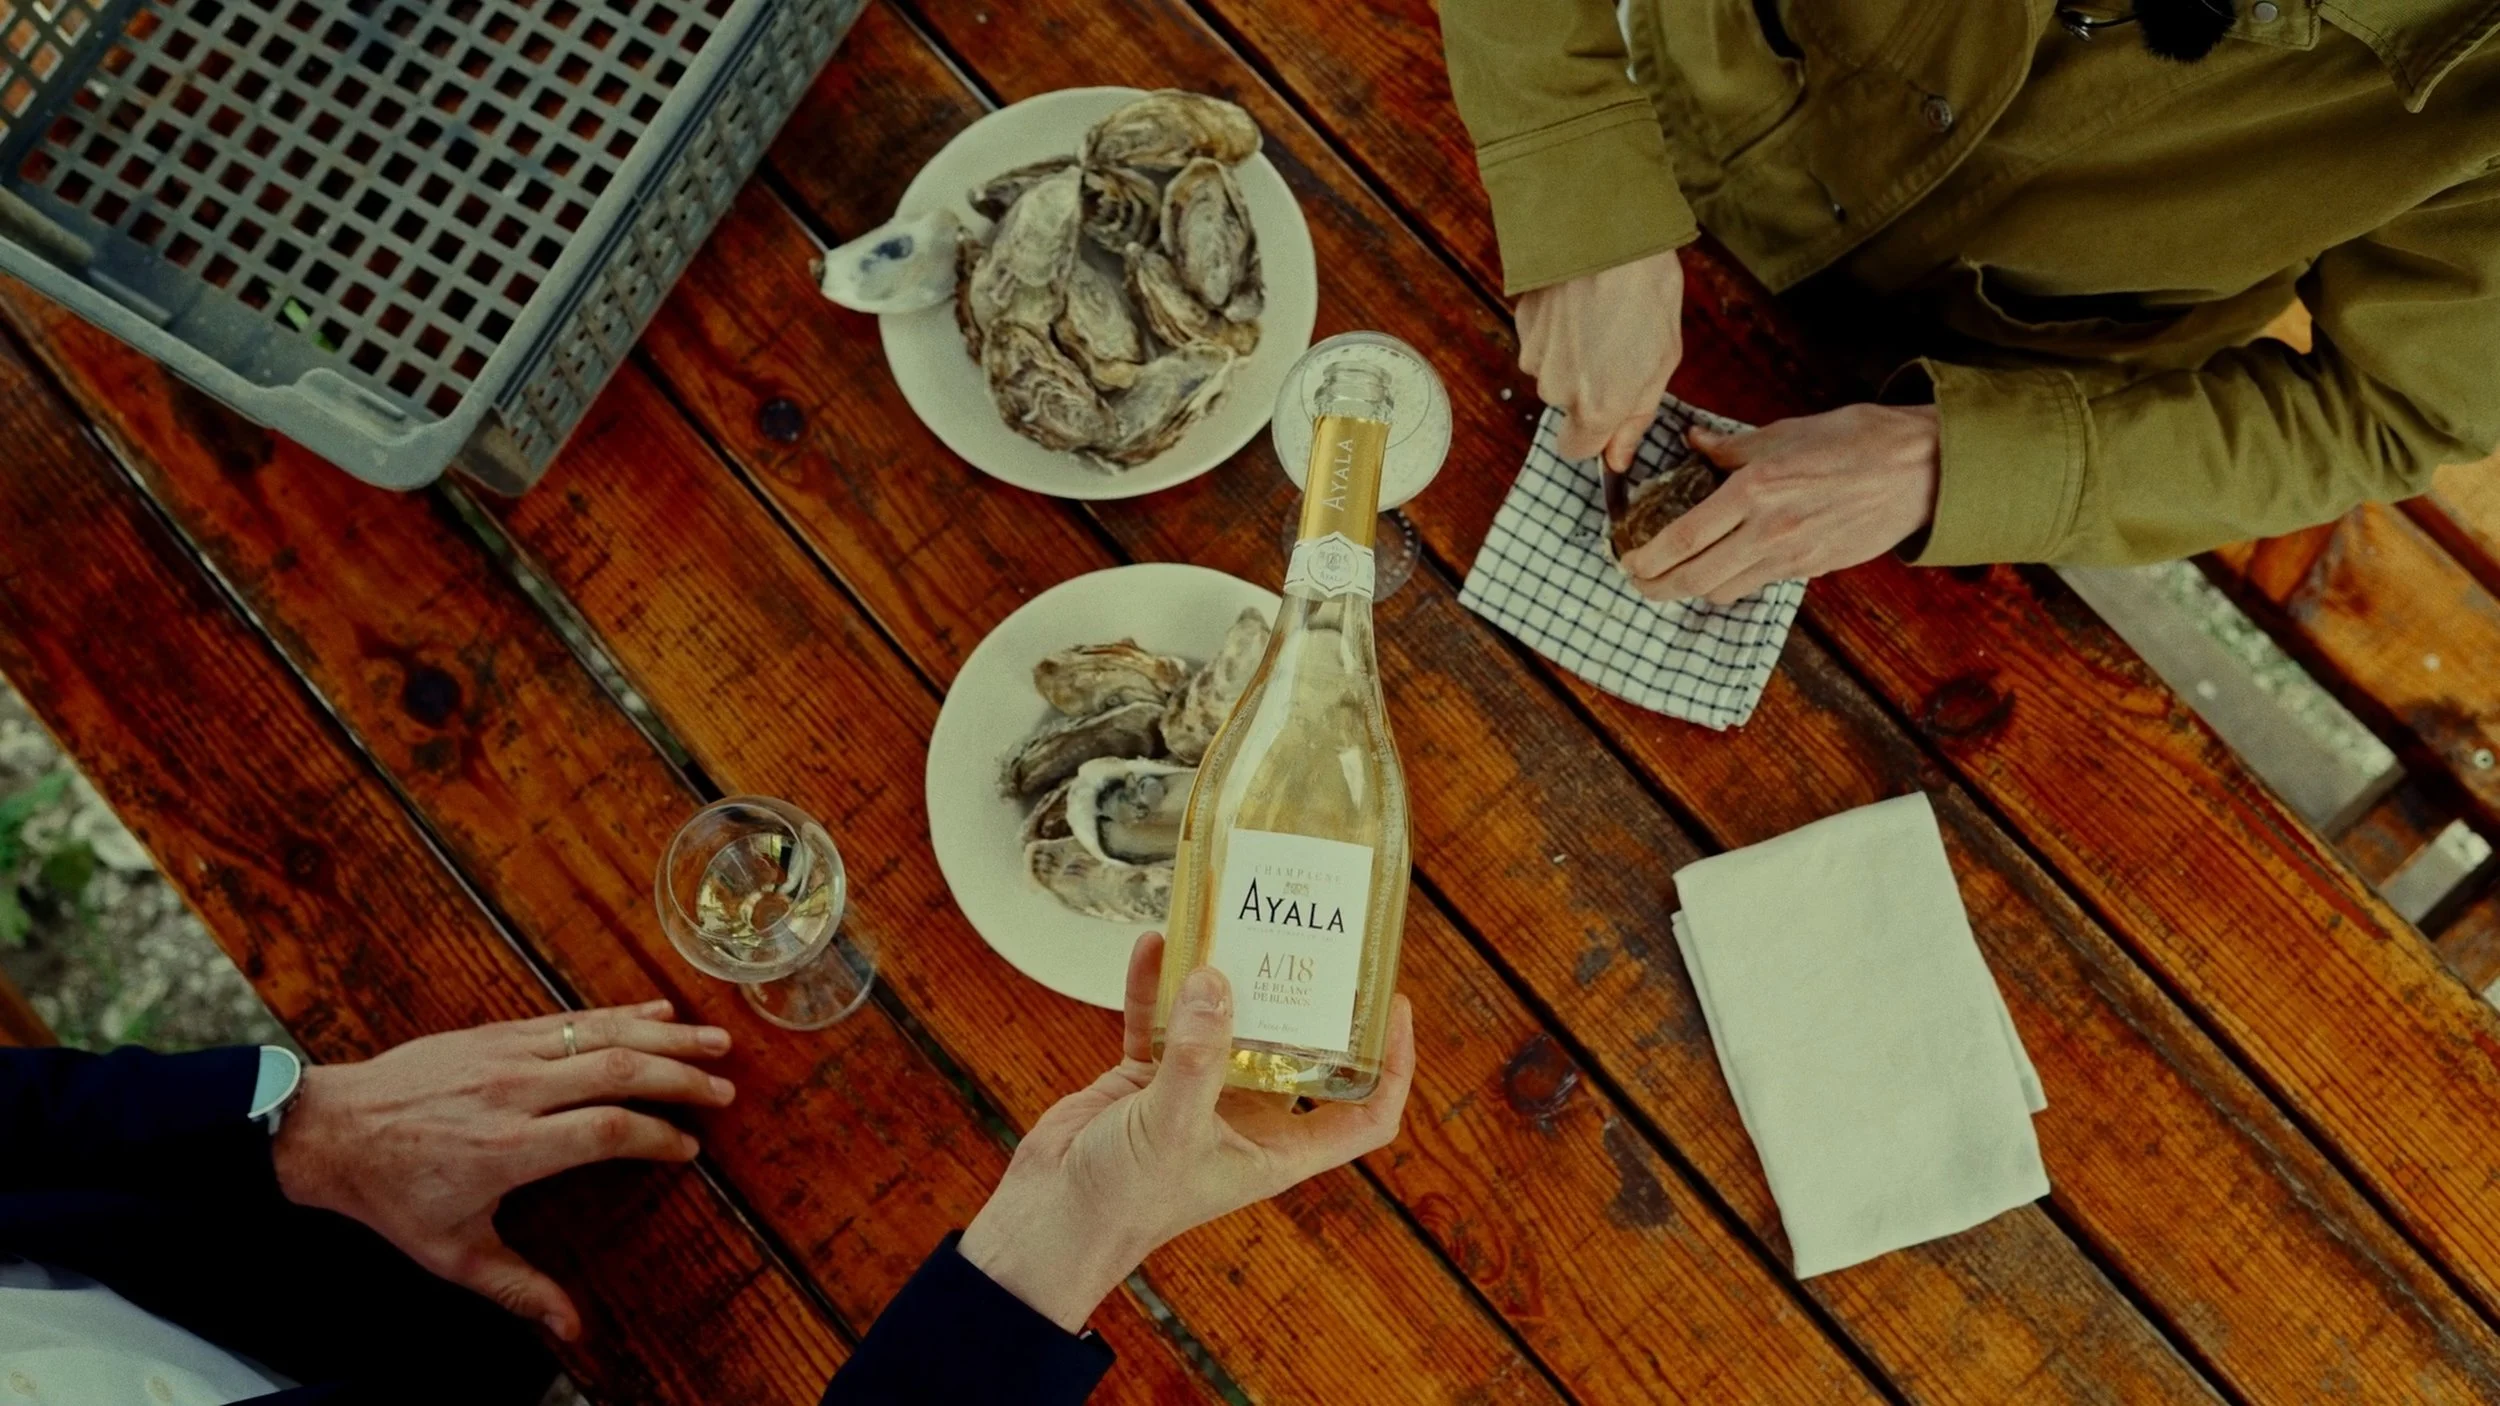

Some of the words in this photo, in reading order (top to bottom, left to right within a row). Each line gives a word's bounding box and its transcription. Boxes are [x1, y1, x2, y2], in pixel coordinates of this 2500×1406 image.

[1322, 439, 1355, 511] AYALA
[1238, 876, 1345, 933] AYALA
[1256, 952, 1314, 983] A/18
[1253, 991, 1268, 1002] DE
[1254, 981, 1268, 991] LE
[1272, 983, 1312, 996] BLANC
